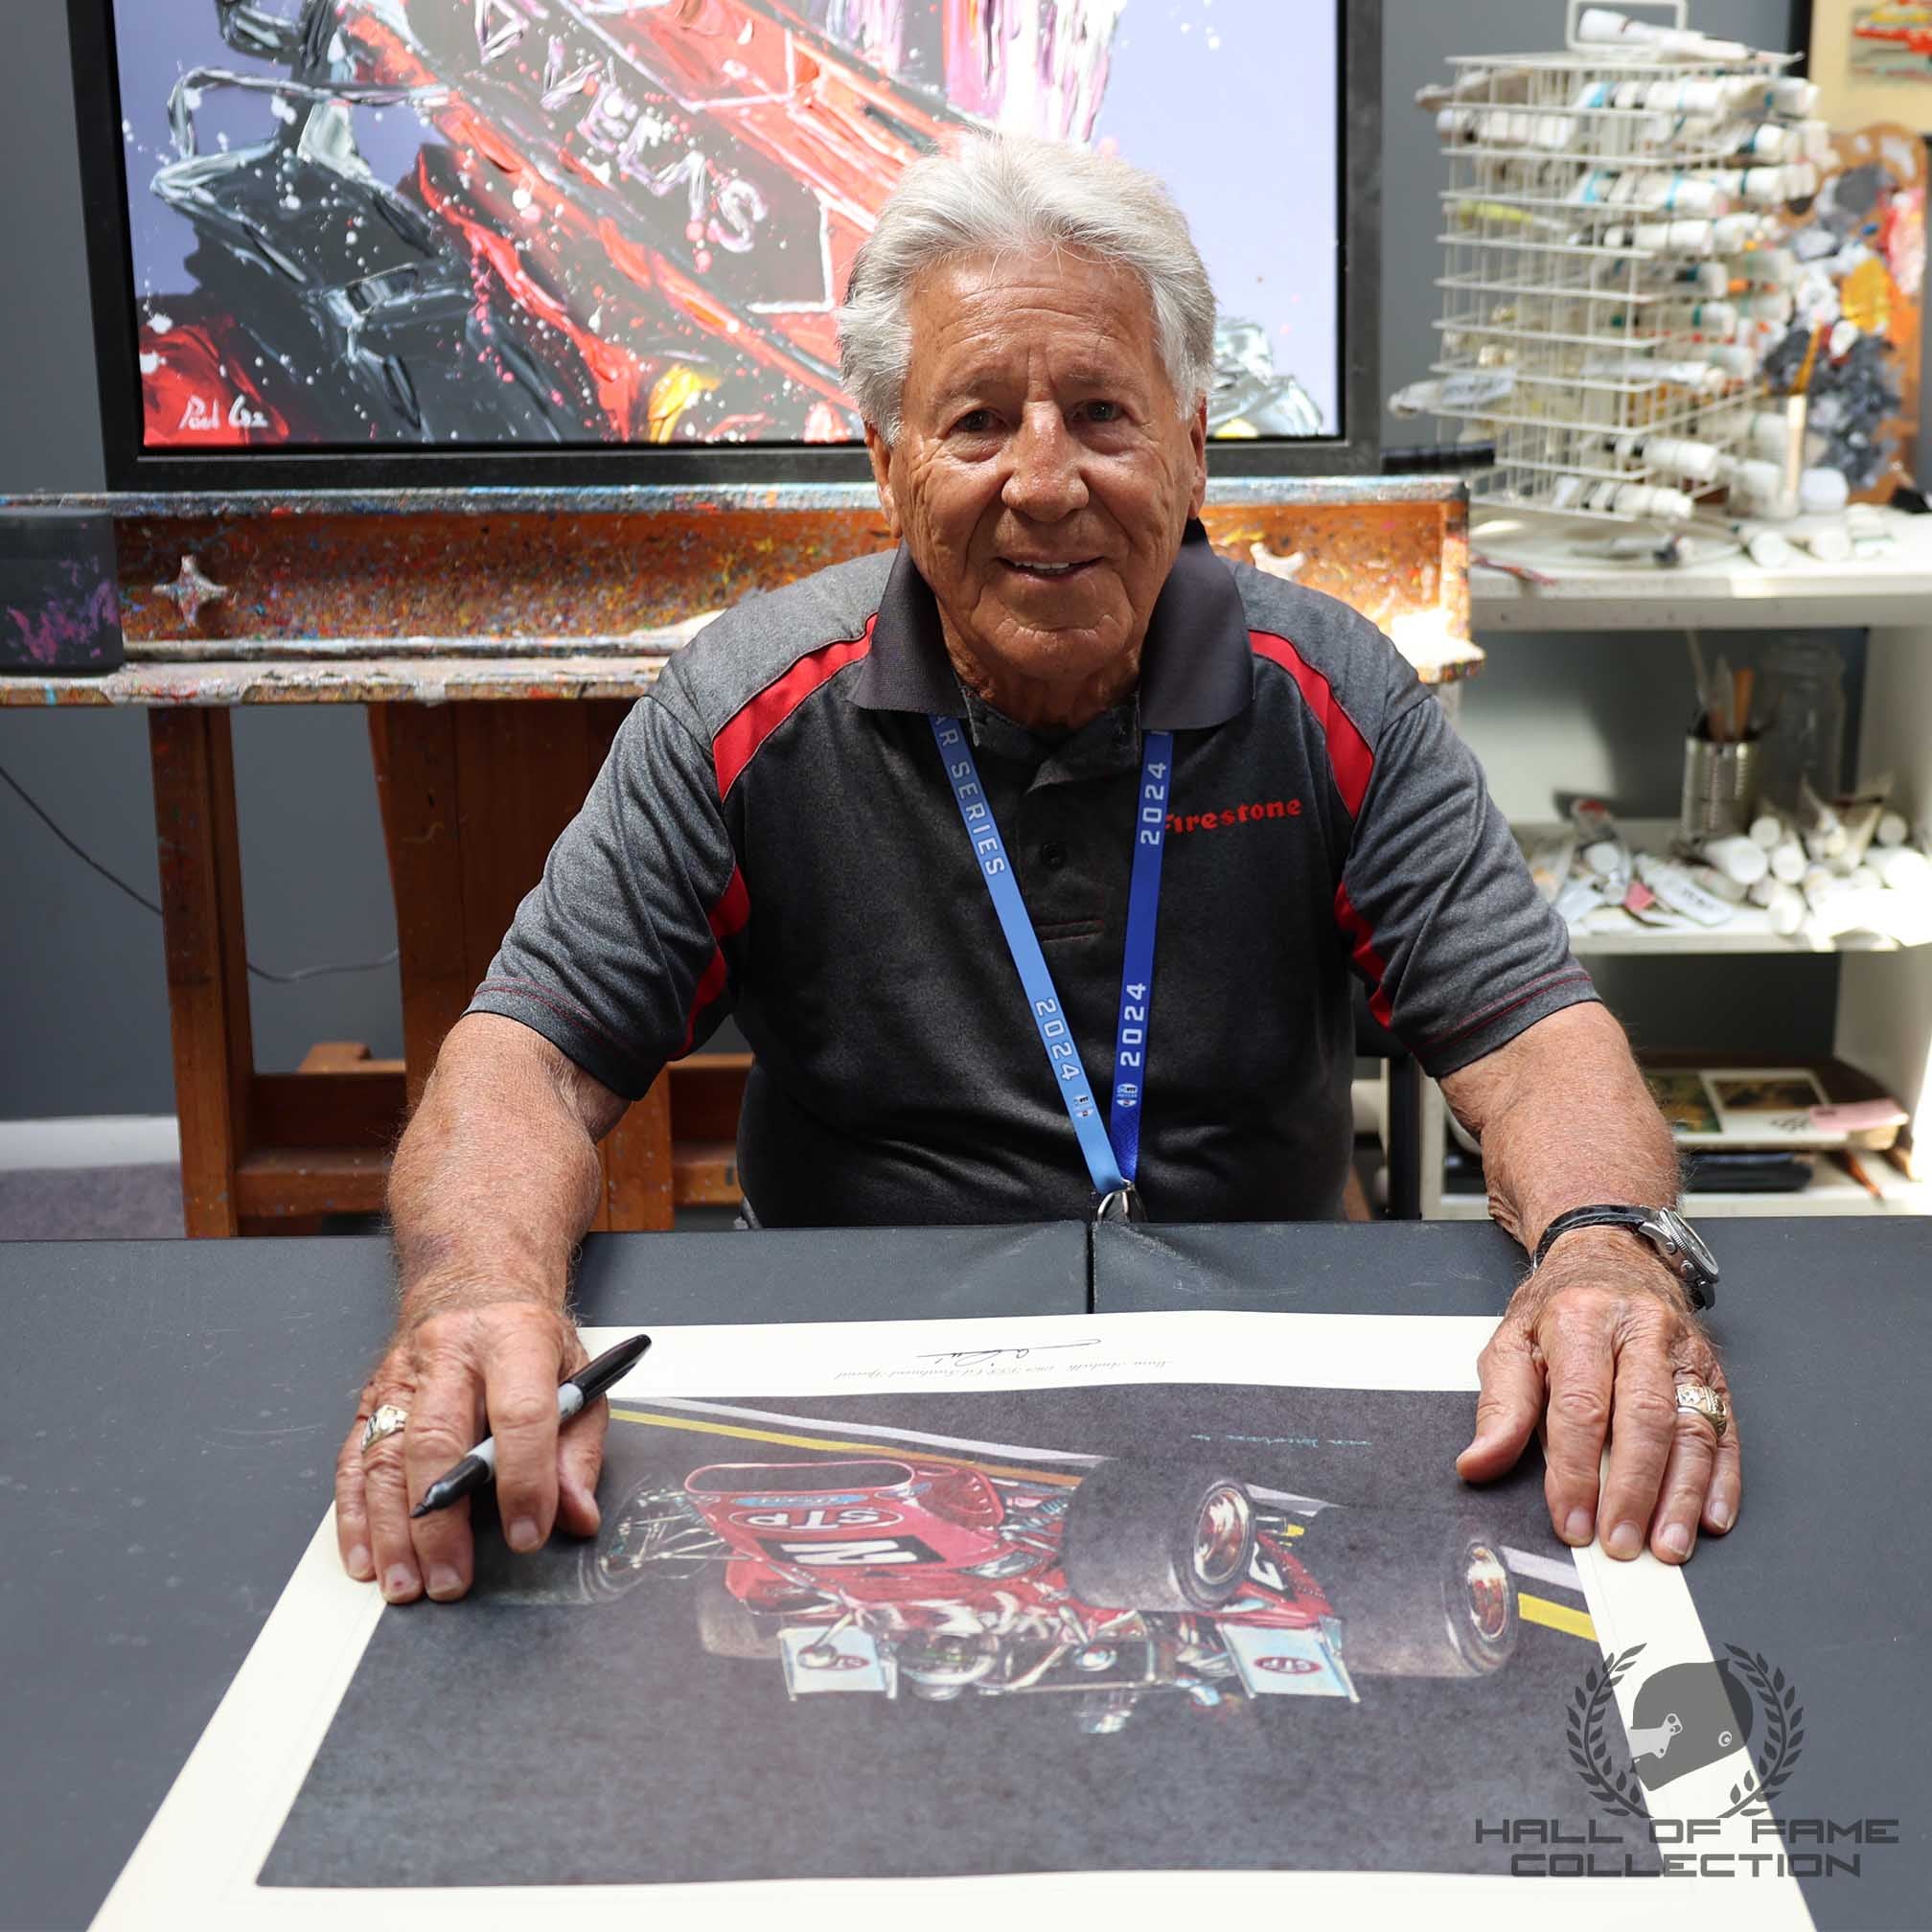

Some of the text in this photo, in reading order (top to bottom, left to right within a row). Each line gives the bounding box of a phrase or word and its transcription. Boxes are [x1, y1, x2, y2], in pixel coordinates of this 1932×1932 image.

[951, 761, 1006, 875] SERIES
[1139, 762, 1166, 845] 2024
[1035, 998, 1081, 1081] 2024
[1119, 982, 1147, 1068] 2024
[747, 1507, 880, 1530] STP
